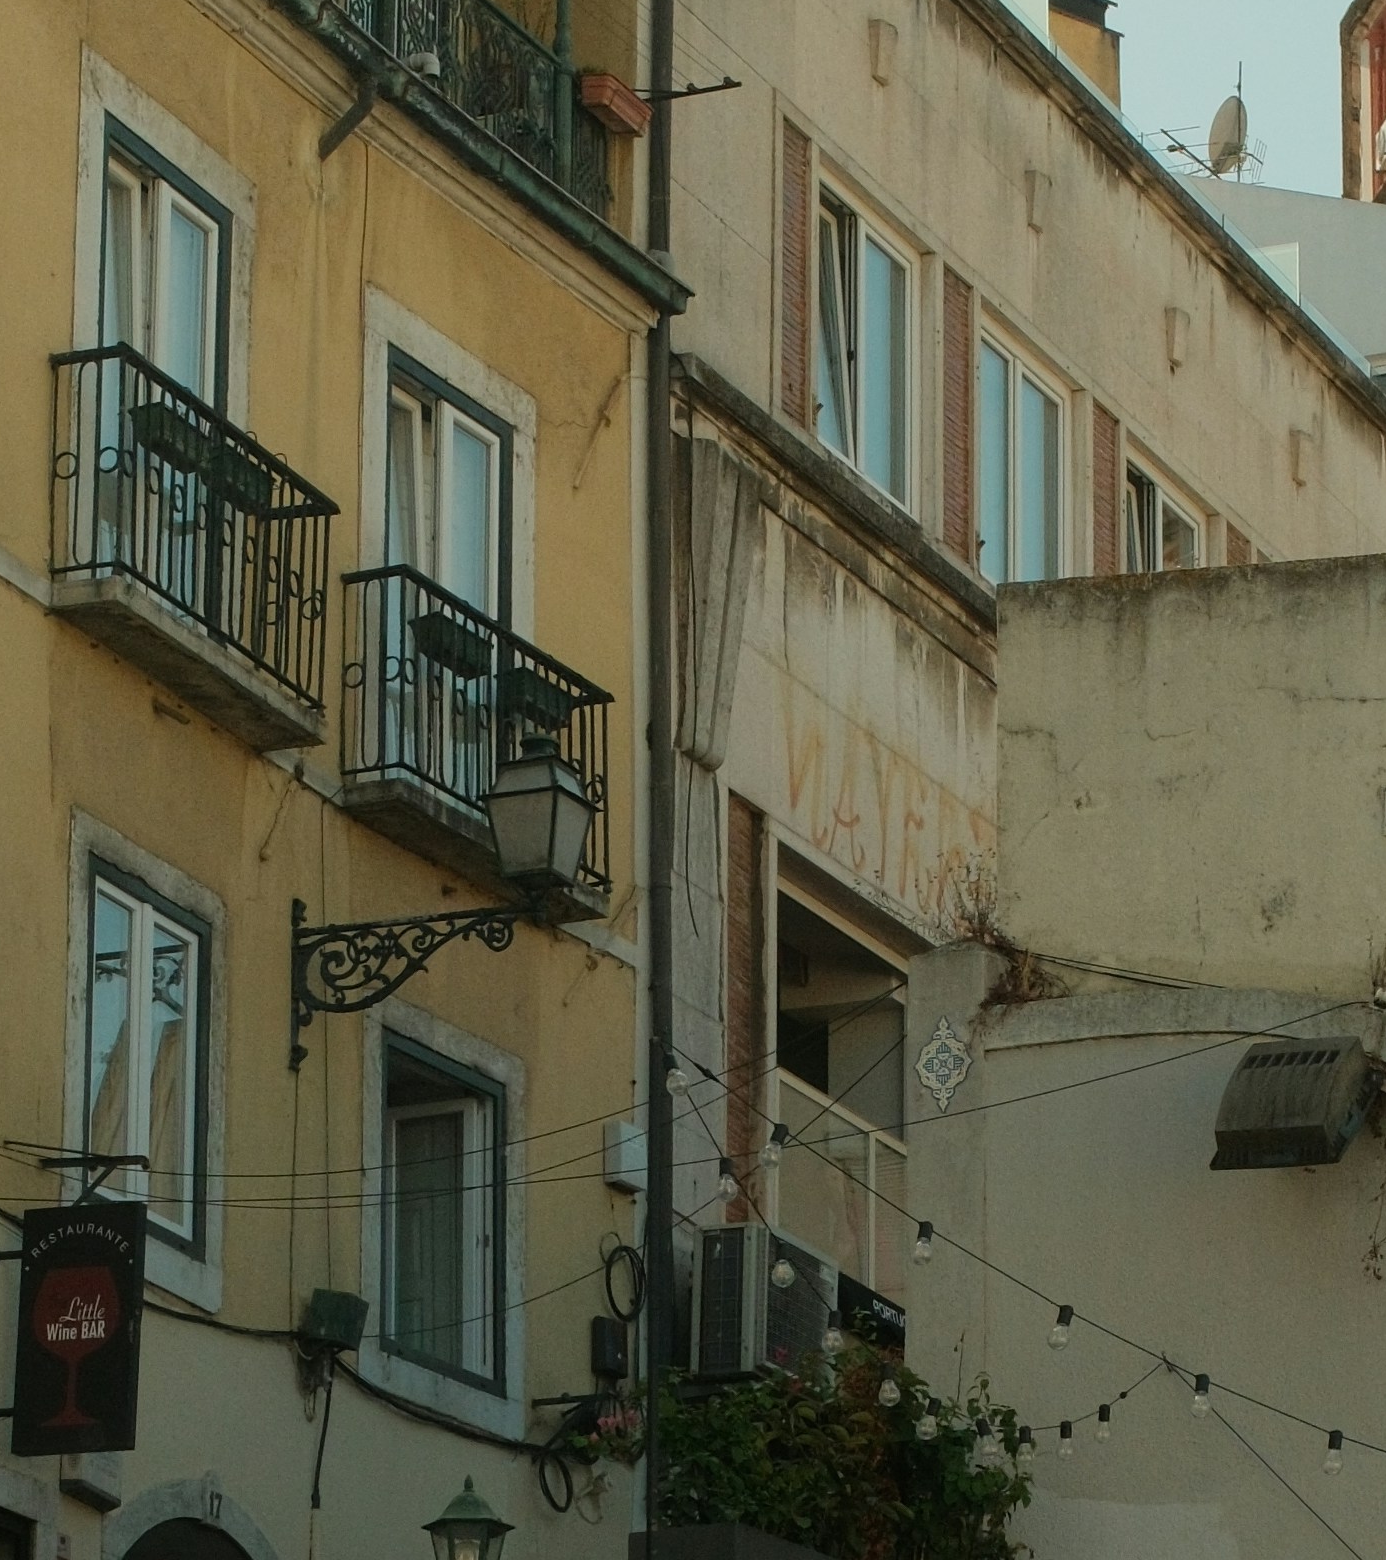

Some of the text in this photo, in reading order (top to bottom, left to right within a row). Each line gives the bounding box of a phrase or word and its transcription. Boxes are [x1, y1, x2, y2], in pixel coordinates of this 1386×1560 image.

[30, 1222, 131, 1260] RESTAURANTE
[59, 1294, 106, 1323] Little
[873, 1299, 905, 1328] PORTU
[46, 1320, 105, 1342] Wine BAR
[210, 1491, 223, 1519] 17
